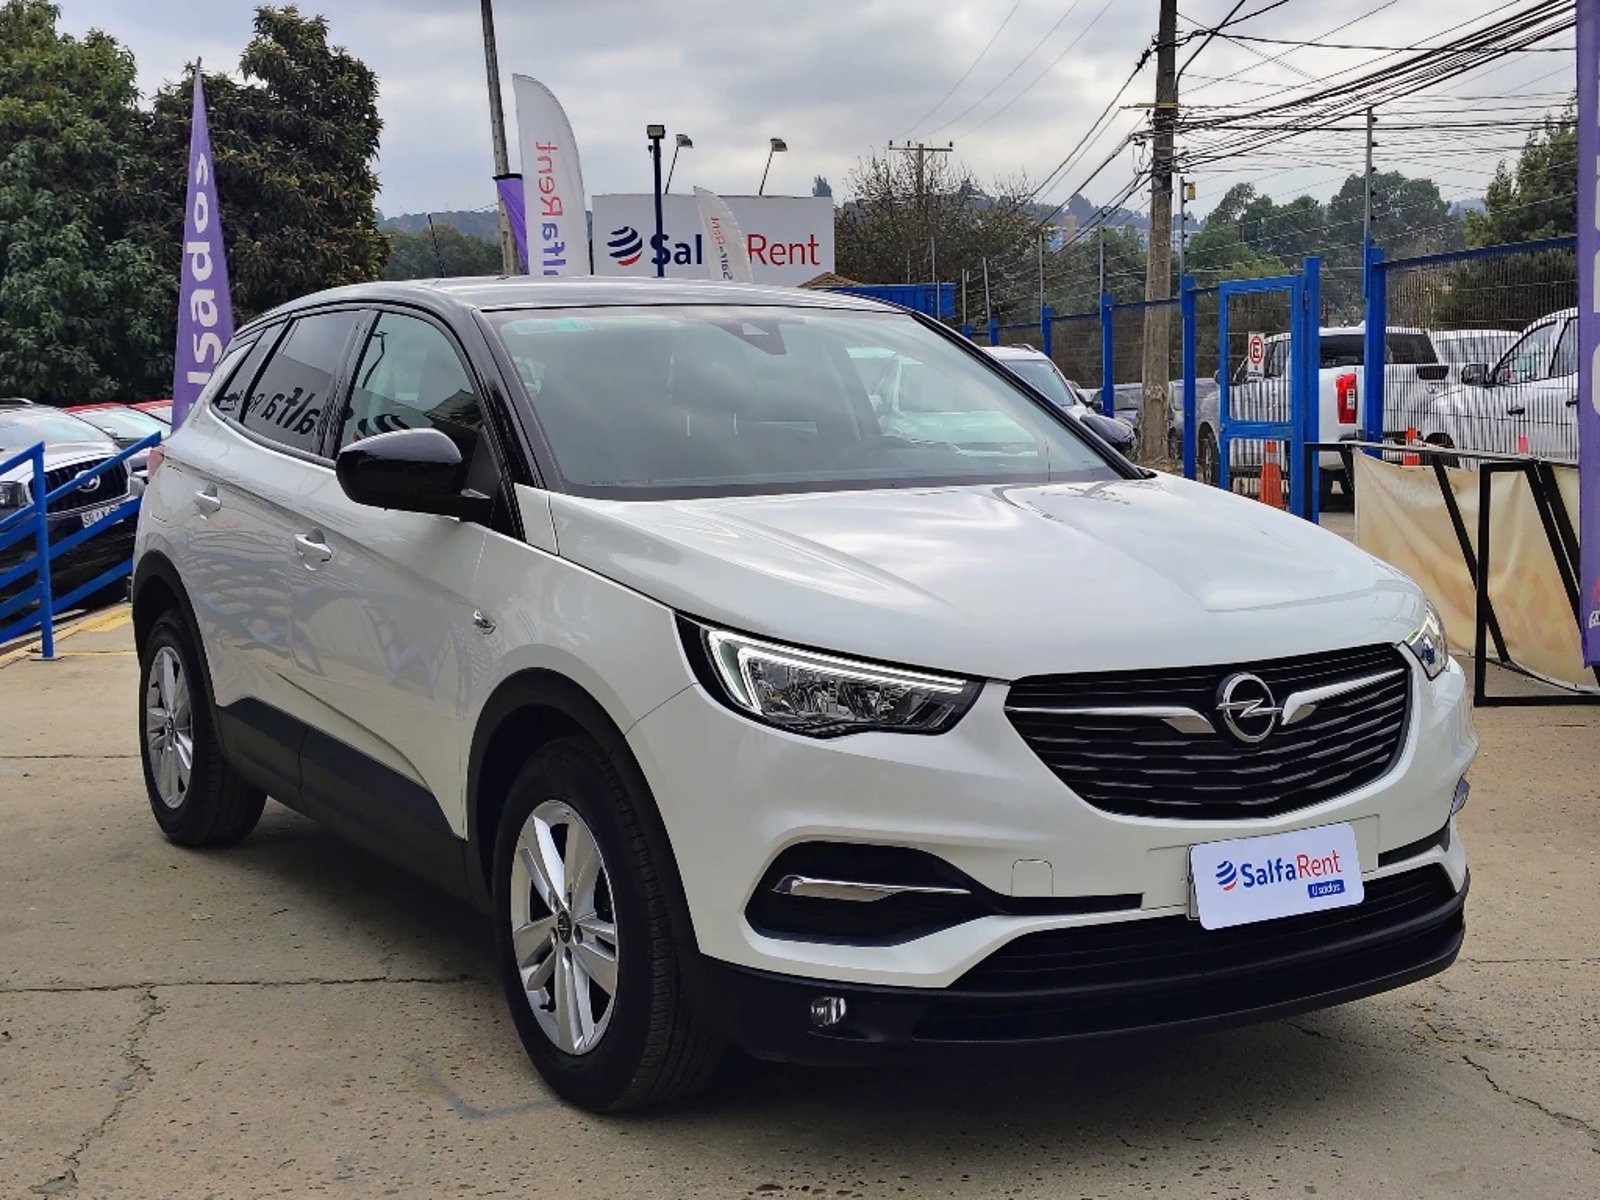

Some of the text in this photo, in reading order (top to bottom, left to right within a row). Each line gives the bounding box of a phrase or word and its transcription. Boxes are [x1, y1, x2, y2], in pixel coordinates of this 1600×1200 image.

[650, 233, 821, 267] SalRent
[1240, 849, 1342, 888] SalfaRent
[1310, 882, 1341, 896] Usados
